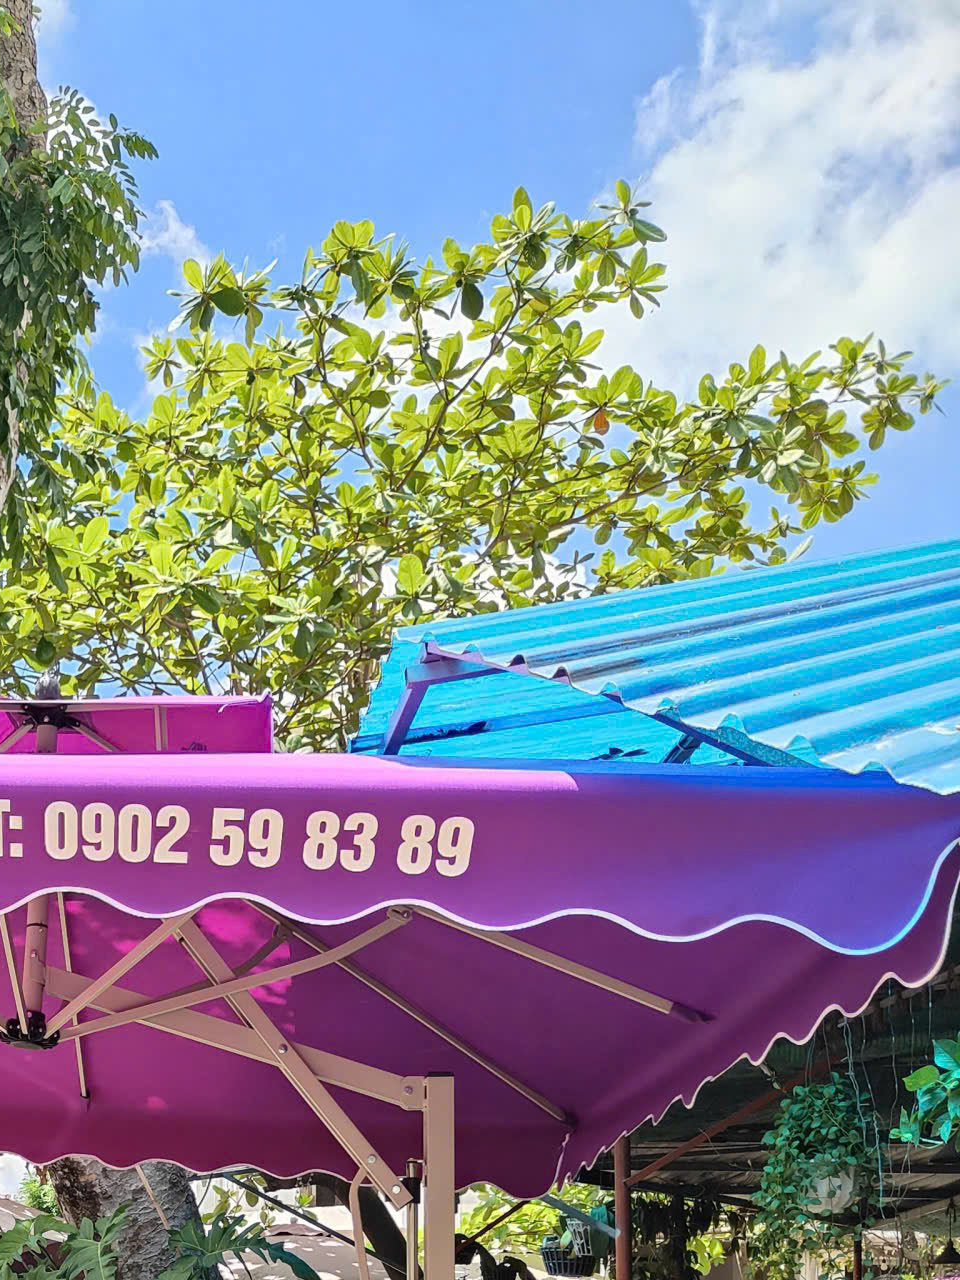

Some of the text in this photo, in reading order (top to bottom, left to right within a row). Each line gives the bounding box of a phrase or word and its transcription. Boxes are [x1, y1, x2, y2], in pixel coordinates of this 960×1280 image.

[44, 800, 191, 864] 0902
[209, 807, 284, 869] 59
[302, 810, 379, 873] 83
[396, 814, 475, 877] 89
